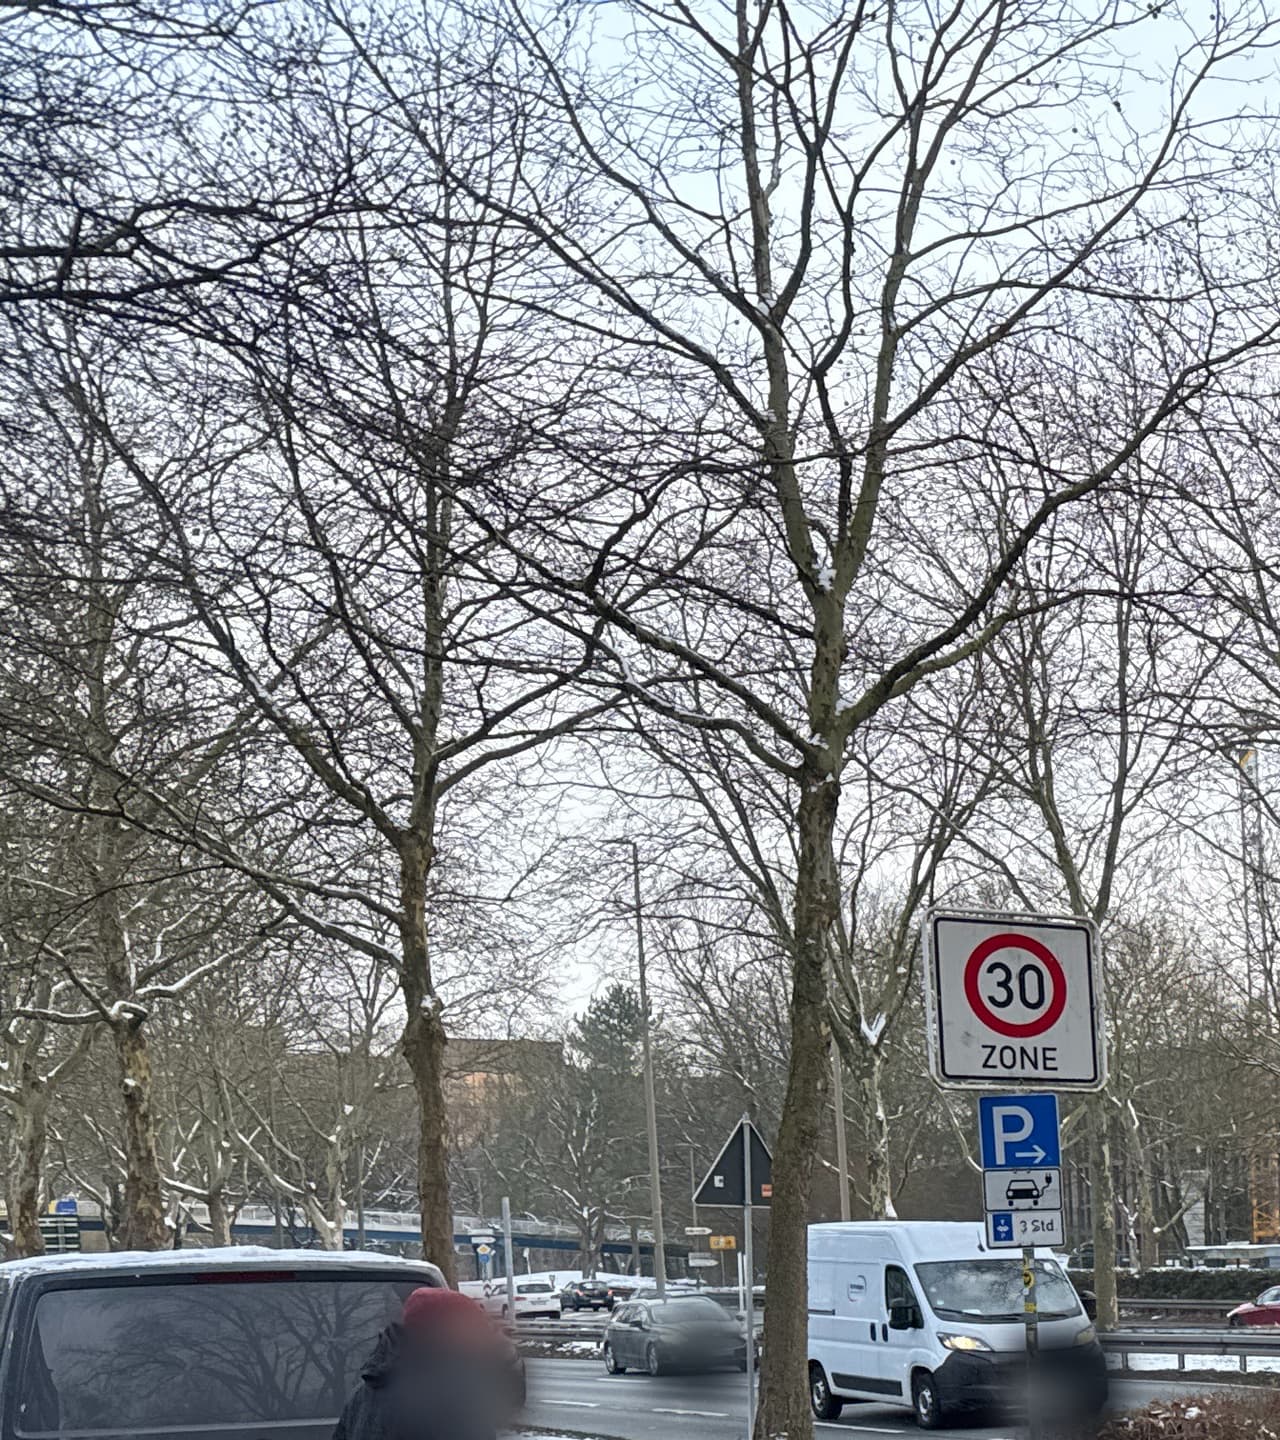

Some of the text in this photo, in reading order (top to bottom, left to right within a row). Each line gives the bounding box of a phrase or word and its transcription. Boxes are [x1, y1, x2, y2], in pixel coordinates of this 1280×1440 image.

[986, 962, 1045, 1010] 30
[981, 1044, 1058, 1071] ZONE
[992, 1105, 1034, 1166] P
[1019, 1220, 1028, 1234] 3
